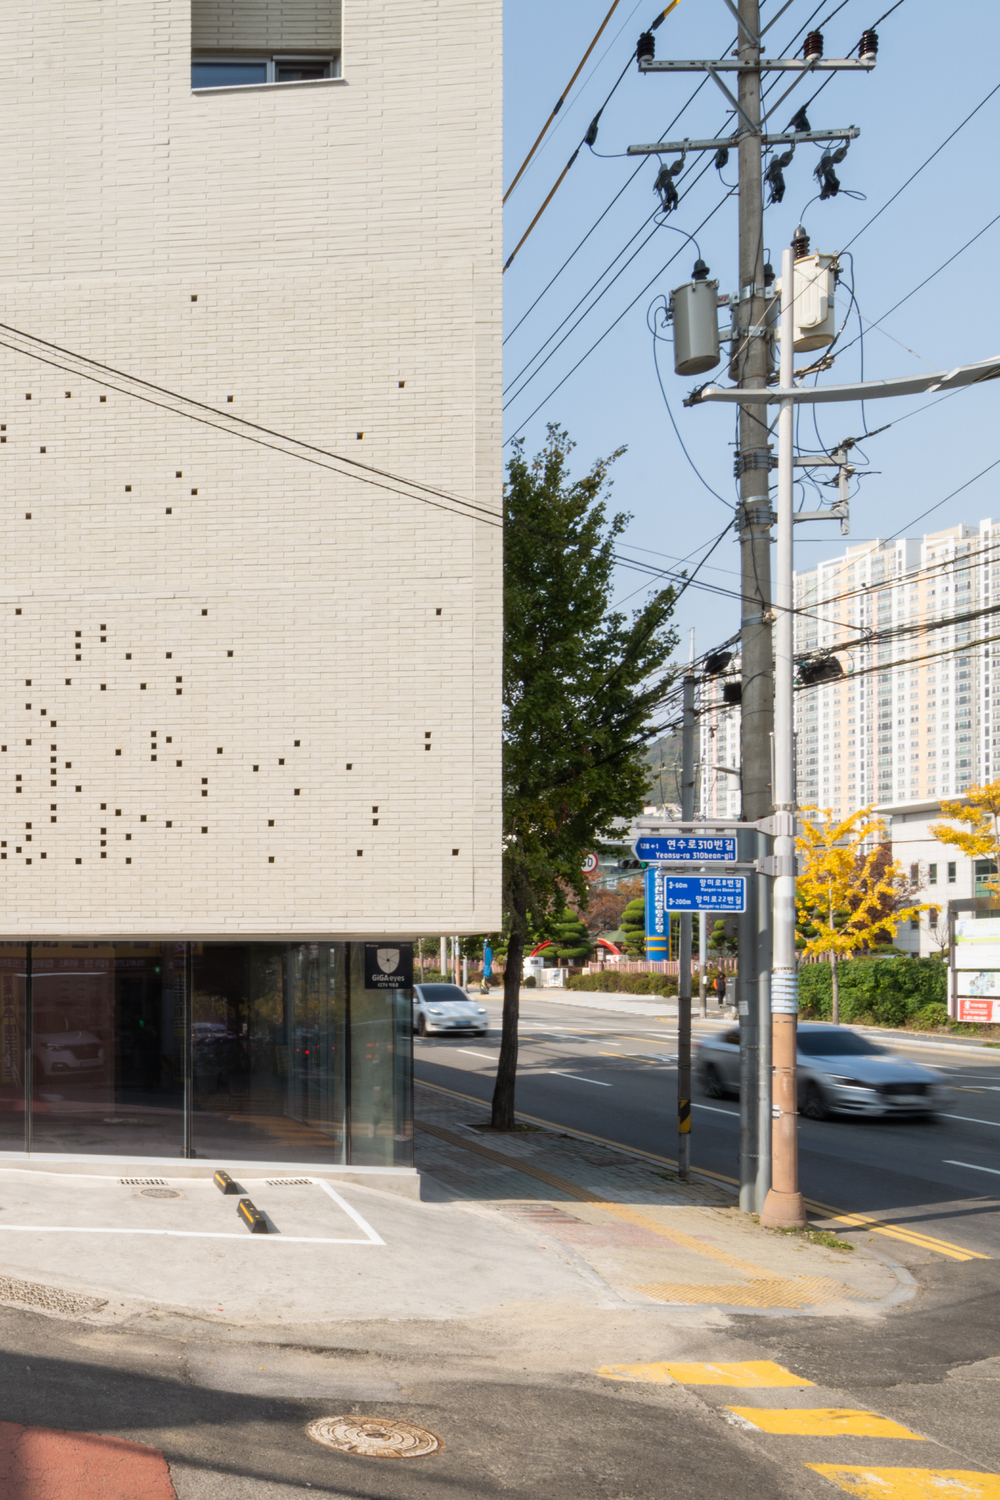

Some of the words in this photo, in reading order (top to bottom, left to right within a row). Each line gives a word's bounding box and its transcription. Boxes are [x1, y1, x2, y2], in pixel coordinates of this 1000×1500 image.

[667, 839, 734, 851] 연수로310번길
[692, 852, 734, 860] 310beon-gil
[699, 879, 742, 888] 망미로8번길
[695, 896, 742, 905] 망미로22번길
